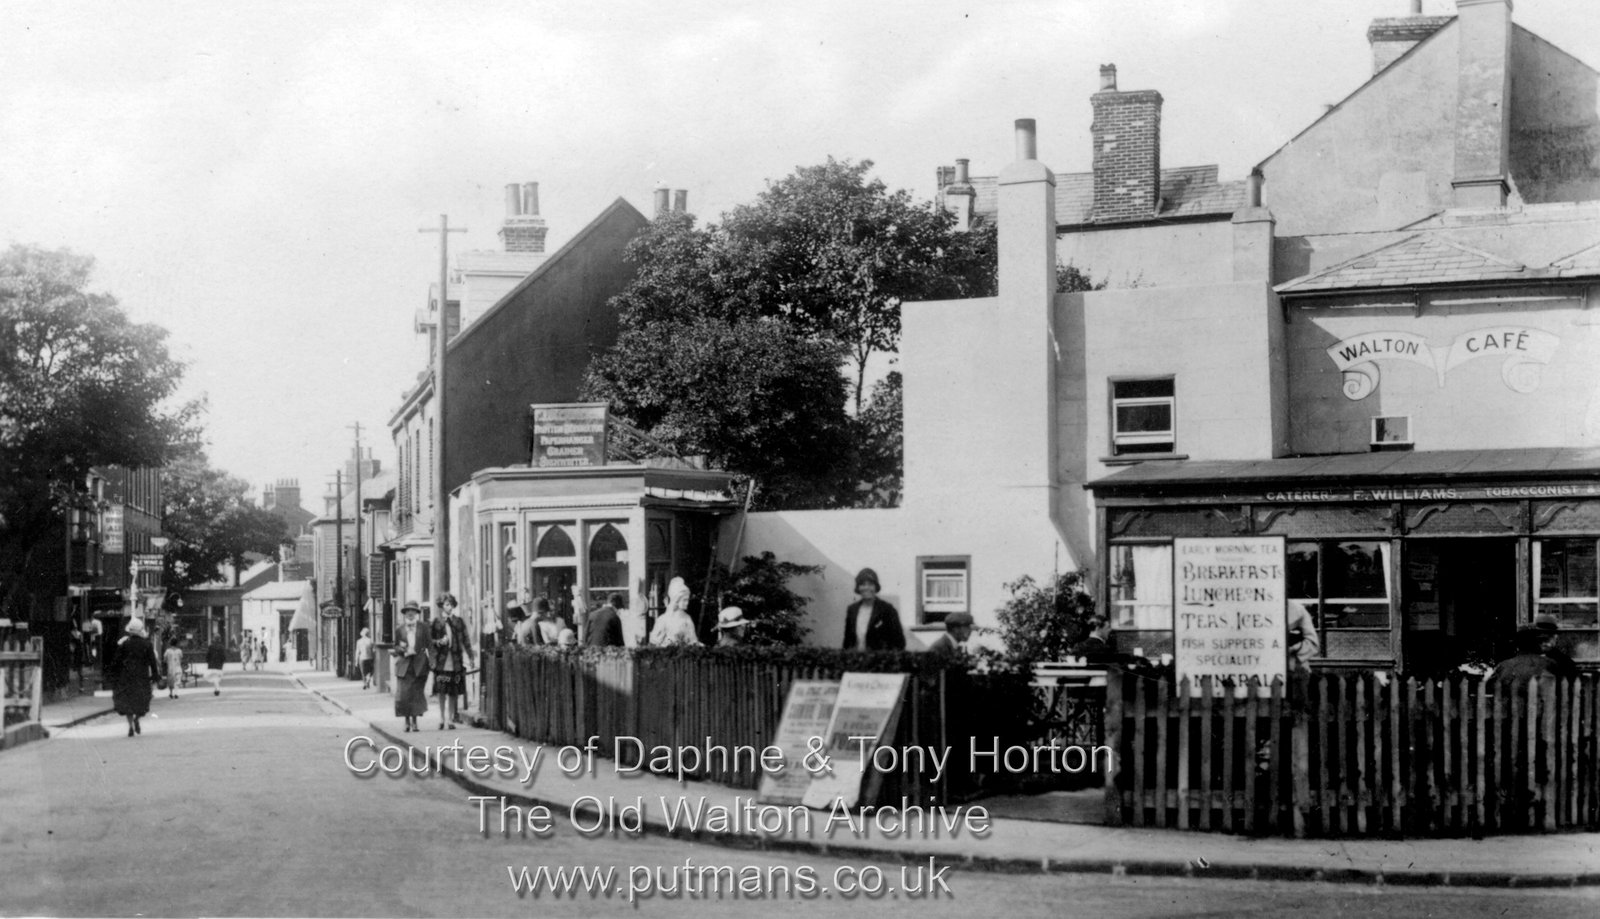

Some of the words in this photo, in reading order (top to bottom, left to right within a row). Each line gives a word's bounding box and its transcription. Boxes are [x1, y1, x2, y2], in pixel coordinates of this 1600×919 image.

[1338, 338, 1420, 362] WALTON
[1465, 330, 1530, 353] CAFÉ
[1266, 491, 1329, 502] CATERER
[1484, 485, 1579, 498] TOBACCONIST
[1181, 544, 1211, 554] EARLY
[1215, 544, 1257, 554] MORNING
[1260, 544, 1278, 554] TEA
[1182, 638, 1205, 649] FISH
[1211, 638, 1265, 649] SUPPERS
[1196, 654, 1260, 666] SPECIALITY
